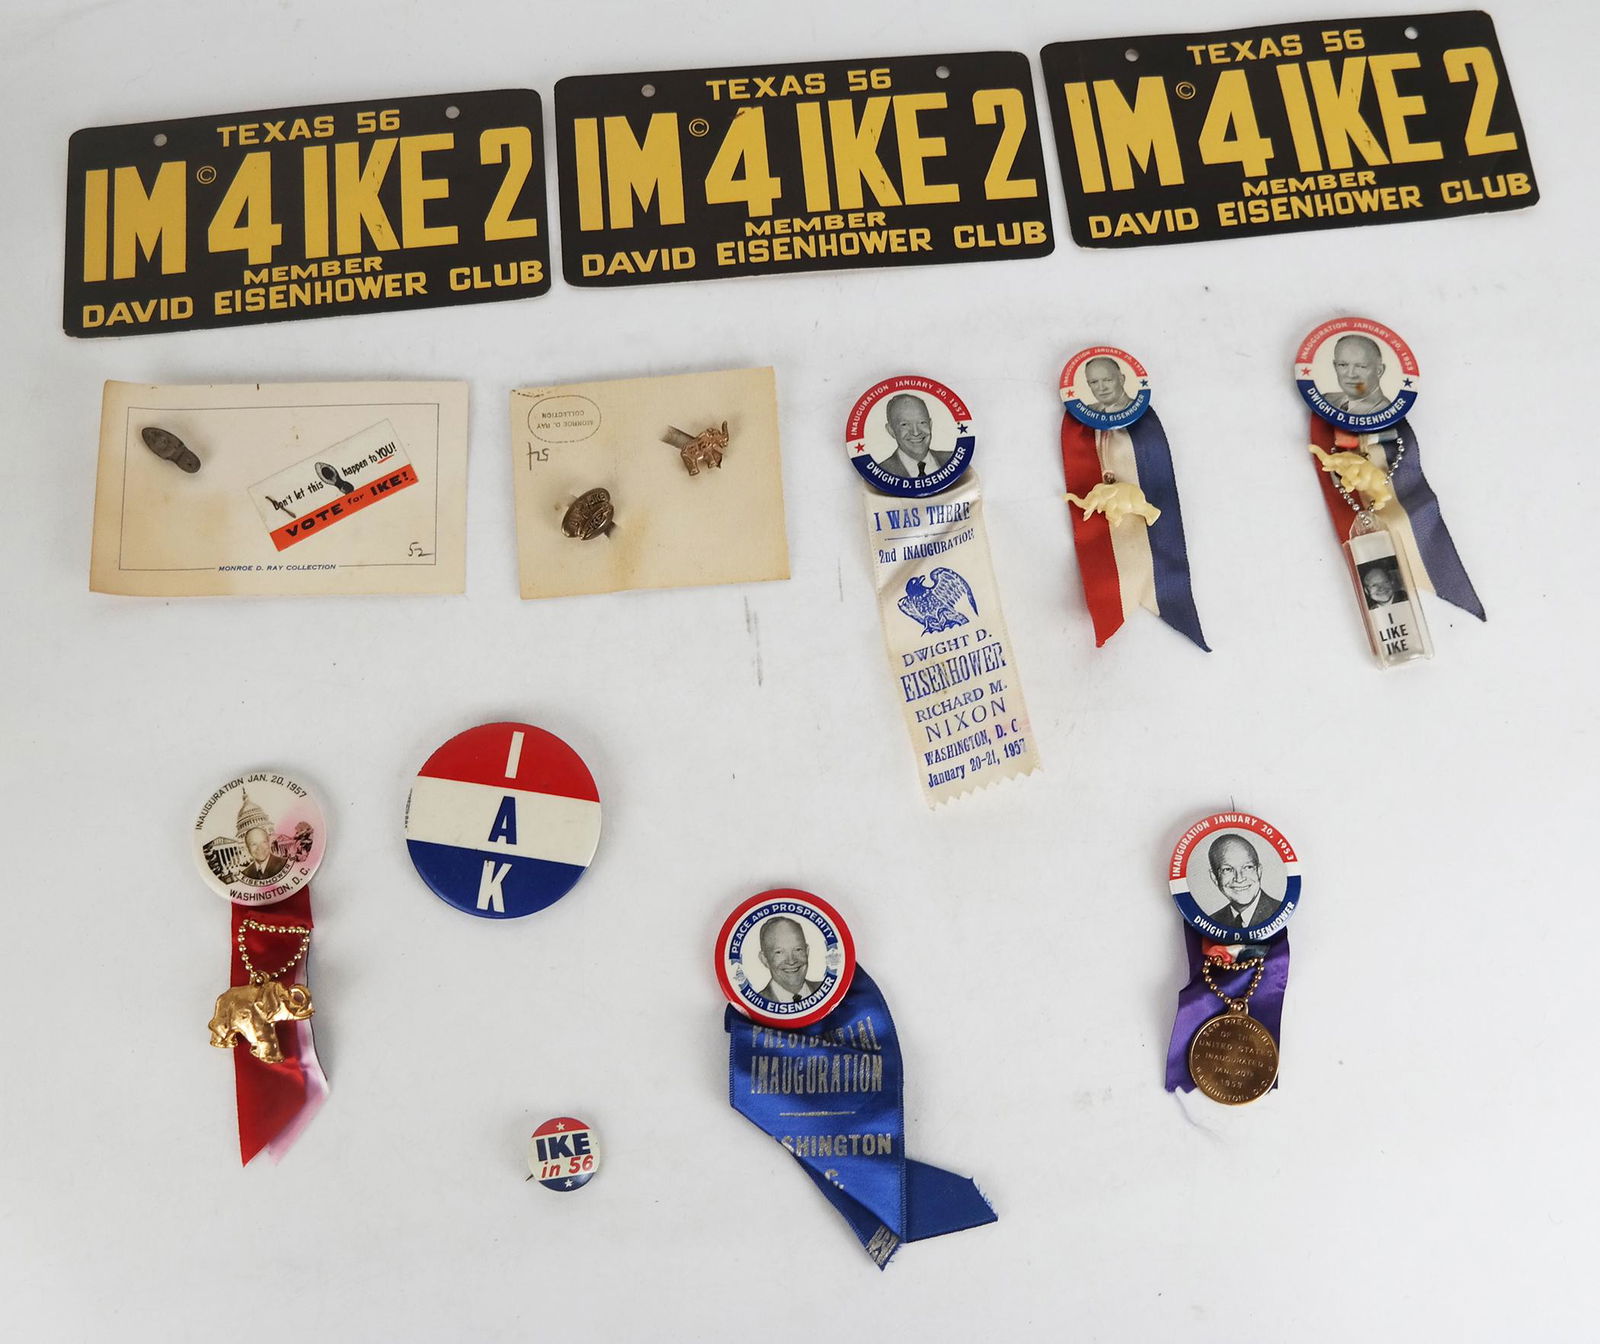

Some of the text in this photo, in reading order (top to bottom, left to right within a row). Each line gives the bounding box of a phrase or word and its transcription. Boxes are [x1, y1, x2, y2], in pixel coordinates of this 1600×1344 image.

[1187, 29, 1365, 65] TEXAS 56
[706, 68, 891, 101] TEXAS 56
[216, 110, 400, 147] TEXAS 56
[1064, 46, 1518, 193] IM 4 IKE 2
[574, 88, 1038, 231] IM 4 IKE 2
[1242, 171, 1376, 197] MEMBER
[83, 126, 538, 283] IM 4 IKE 2
[745, 212, 886, 237] MEMBER
[1088, 173, 1532, 239] DAVID EISENHOWER CLUB
[581, 221, 1047, 277] DAVID EISENHOWER CLUB
[243, 257, 383, 286] MEMBER
[83, 260, 544, 328] DAVID EISENHOWER CLUB
[1302, 322, 1347, 360] INAUGURATION
[1353, 323, 1389, 338] JANUARY
[851, 379, 966, 436] INAUGURATION JANUARY 20, 1957
[1076, 402, 1099, 420] DWIGHT
[1109, 394, 1145, 422] EISENHOWER
[1307, 387, 1406, 425] DWIGHT D. EISENHOWER
[295, 487, 306, 502] let
[307, 481, 324, 496] this
[341, 458, 369, 478] happen
[369, 453, 378, 465] to
[375, 442, 397, 461] YOU!
[866, 446, 967, 489] DWIGHT D. EISENHOWER
[286, 471, 409, 538] VOTE for IKE!
[873, 501, 971, 532] I WAS THERE
[878, 528, 975, 564] 2nd INAUGURATION
[1379, 624, 1409, 642] LIKE
[1388, 612, 1394, 625] I
[902, 628, 993, 668] DWIGHT D.
[1386, 639, 1409, 656] IKE
[900, 642, 1007, 702] EISENHOWER
[915, 679, 1008, 723] RICHARD M.
[925, 697, 1006, 743] NIXON
[924, 729, 992, 766] WASHINGTON,
[995, 724, 1007, 739] D.
[928, 738, 1026, 788] January 20-21, 1957
[195, 777, 244, 830] INAUGURATION
[247, 774, 268, 783] JAN.
[286, 781, 308, 798] 1957
[1172, 814, 1294, 877] INAUGURATION JANUARY 20, 1953
[241, 863, 291, 886] EISENHOWER
[292, 876, 303, 885] D.
[300, 867, 311, 876] C.
[731, 903, 835, 954] PEACE AND PROSPERITY
[1194, 901, 1295, 941] DWIGHT D. EISENHOWER
[744, 975, 835, 1014] With EISENHOWER
[751, 1053, 883, 1095] INAUGURATION
[536, 1132, 591, 1162] IKE
[541, 1155, 594, 1178] in 56
